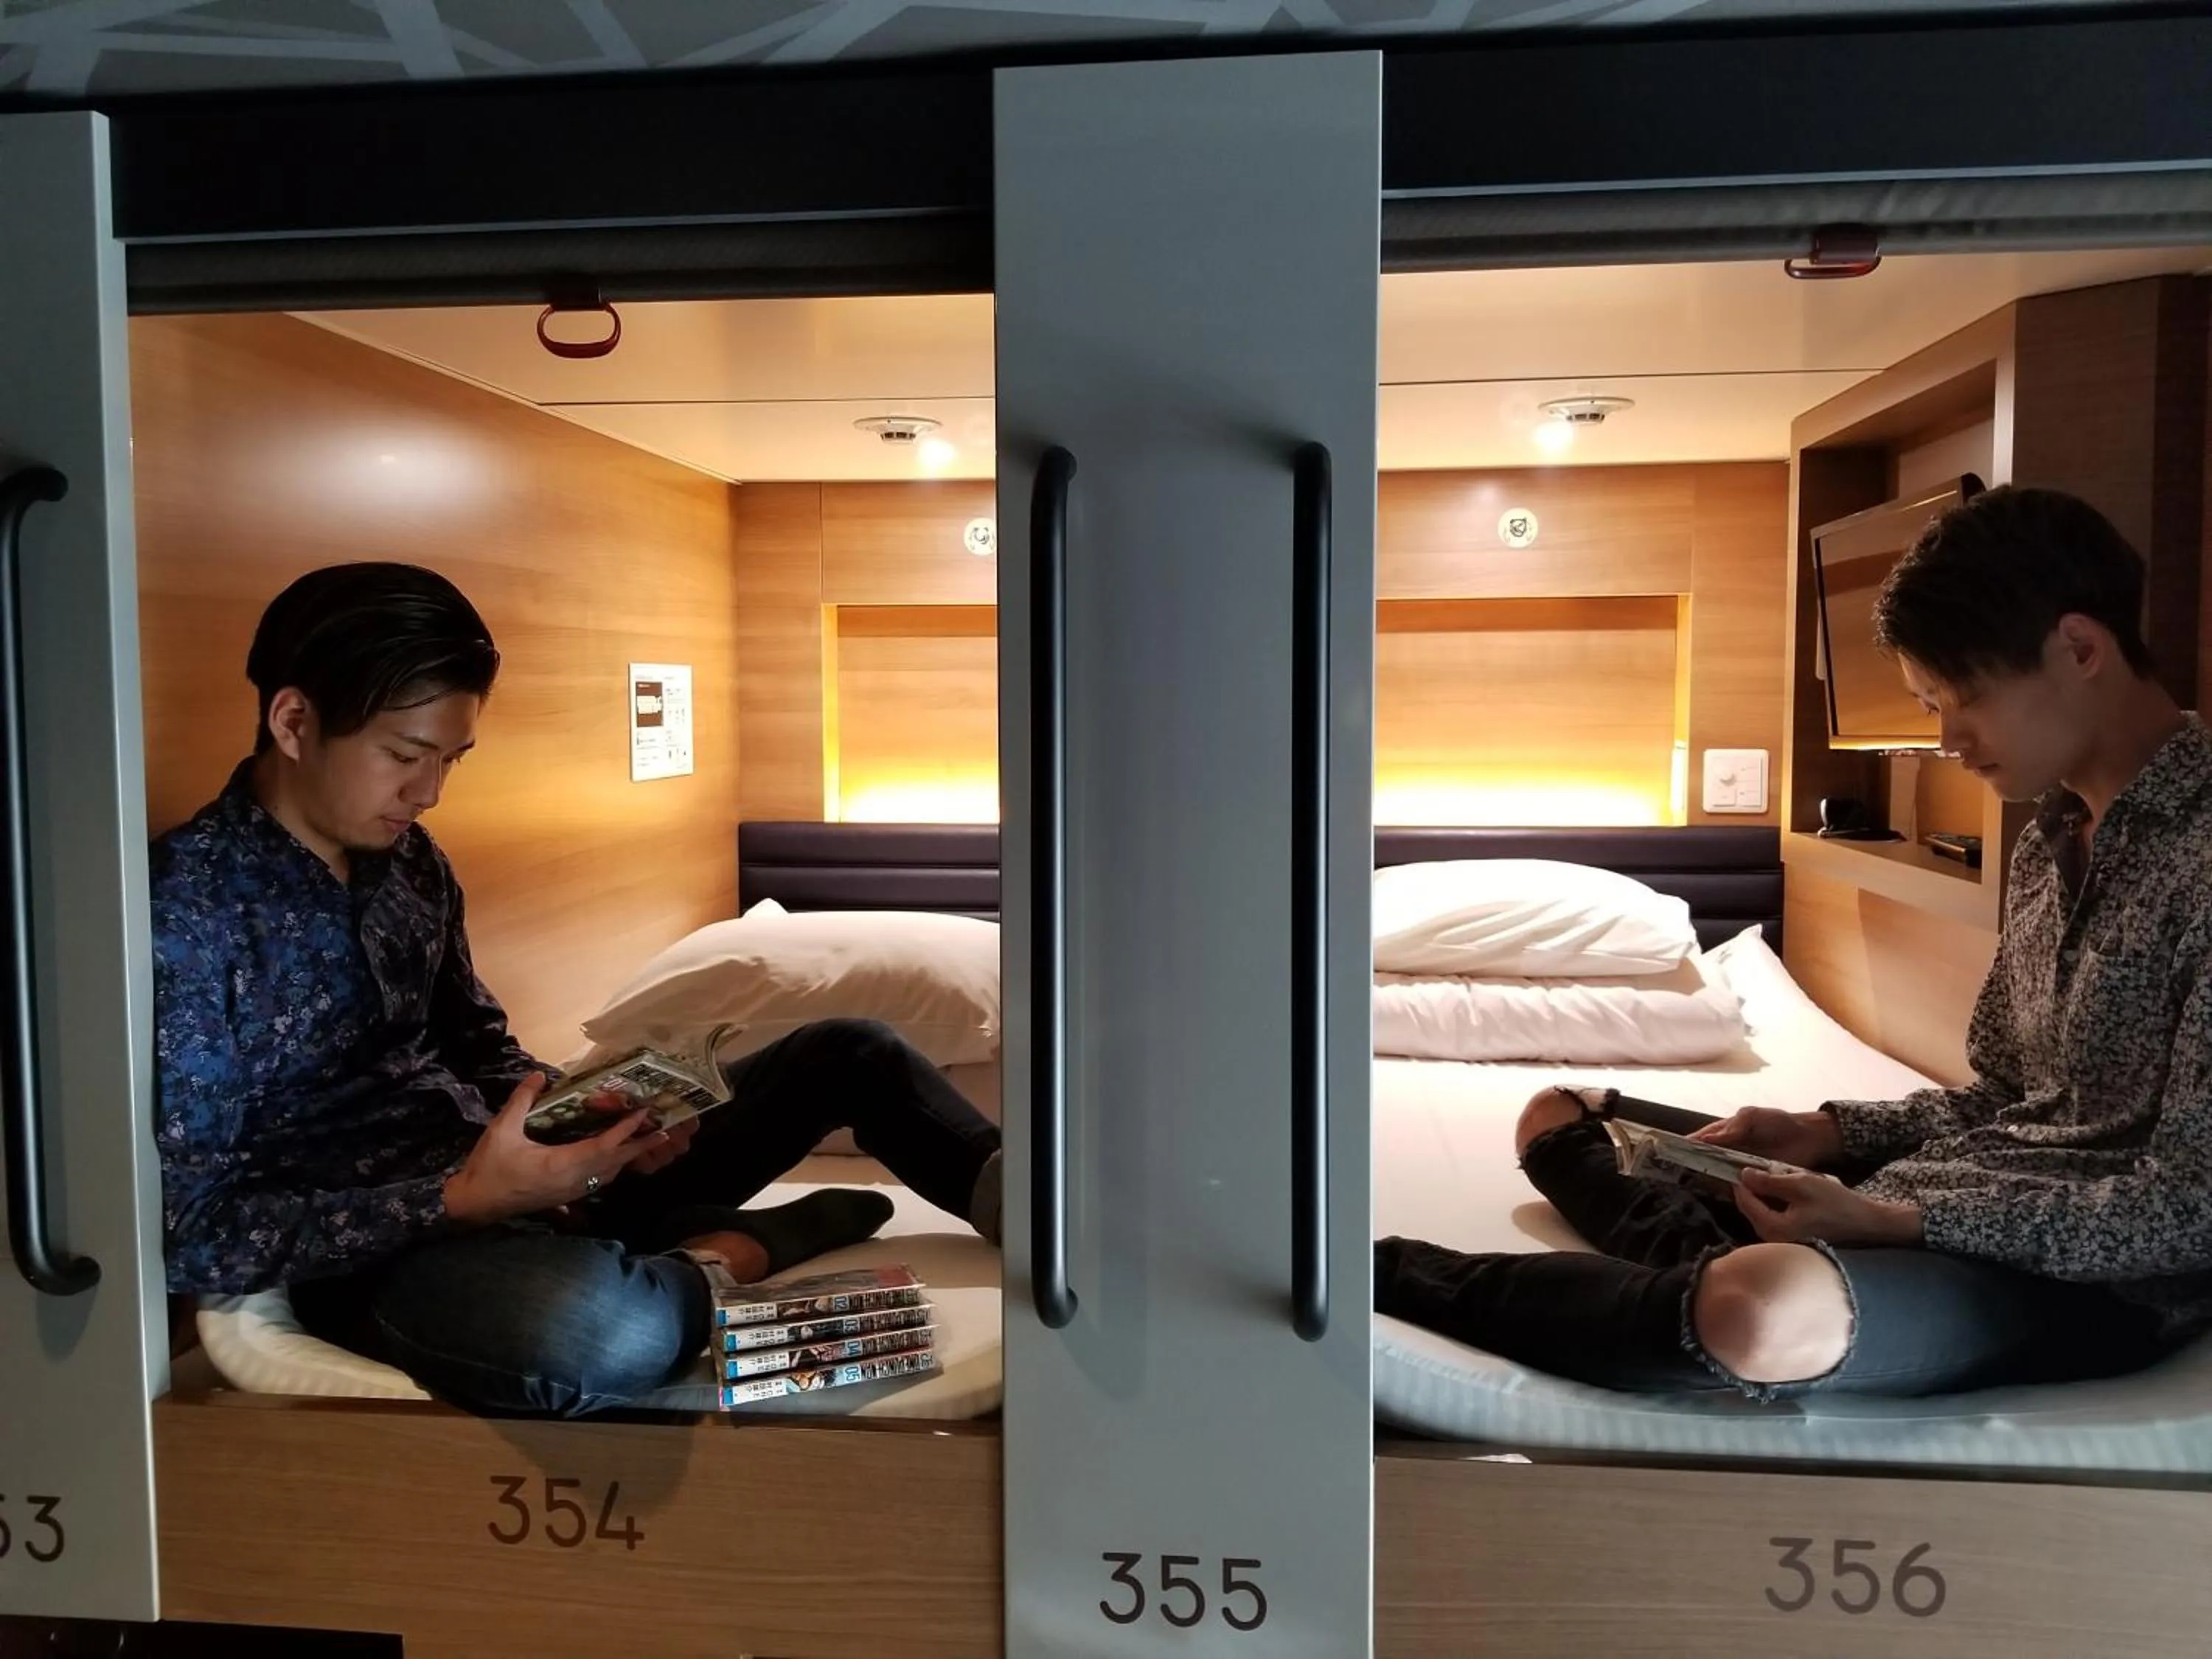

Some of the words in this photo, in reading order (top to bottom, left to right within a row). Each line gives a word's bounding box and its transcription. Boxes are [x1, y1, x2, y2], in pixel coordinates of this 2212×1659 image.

[844, 1366, 860, 1381] 05
[487, 1475, 645, 1551] 354
[1099, 1552, 1267, 1631] 355
[1764, 1537, 1947, 1617] 356
